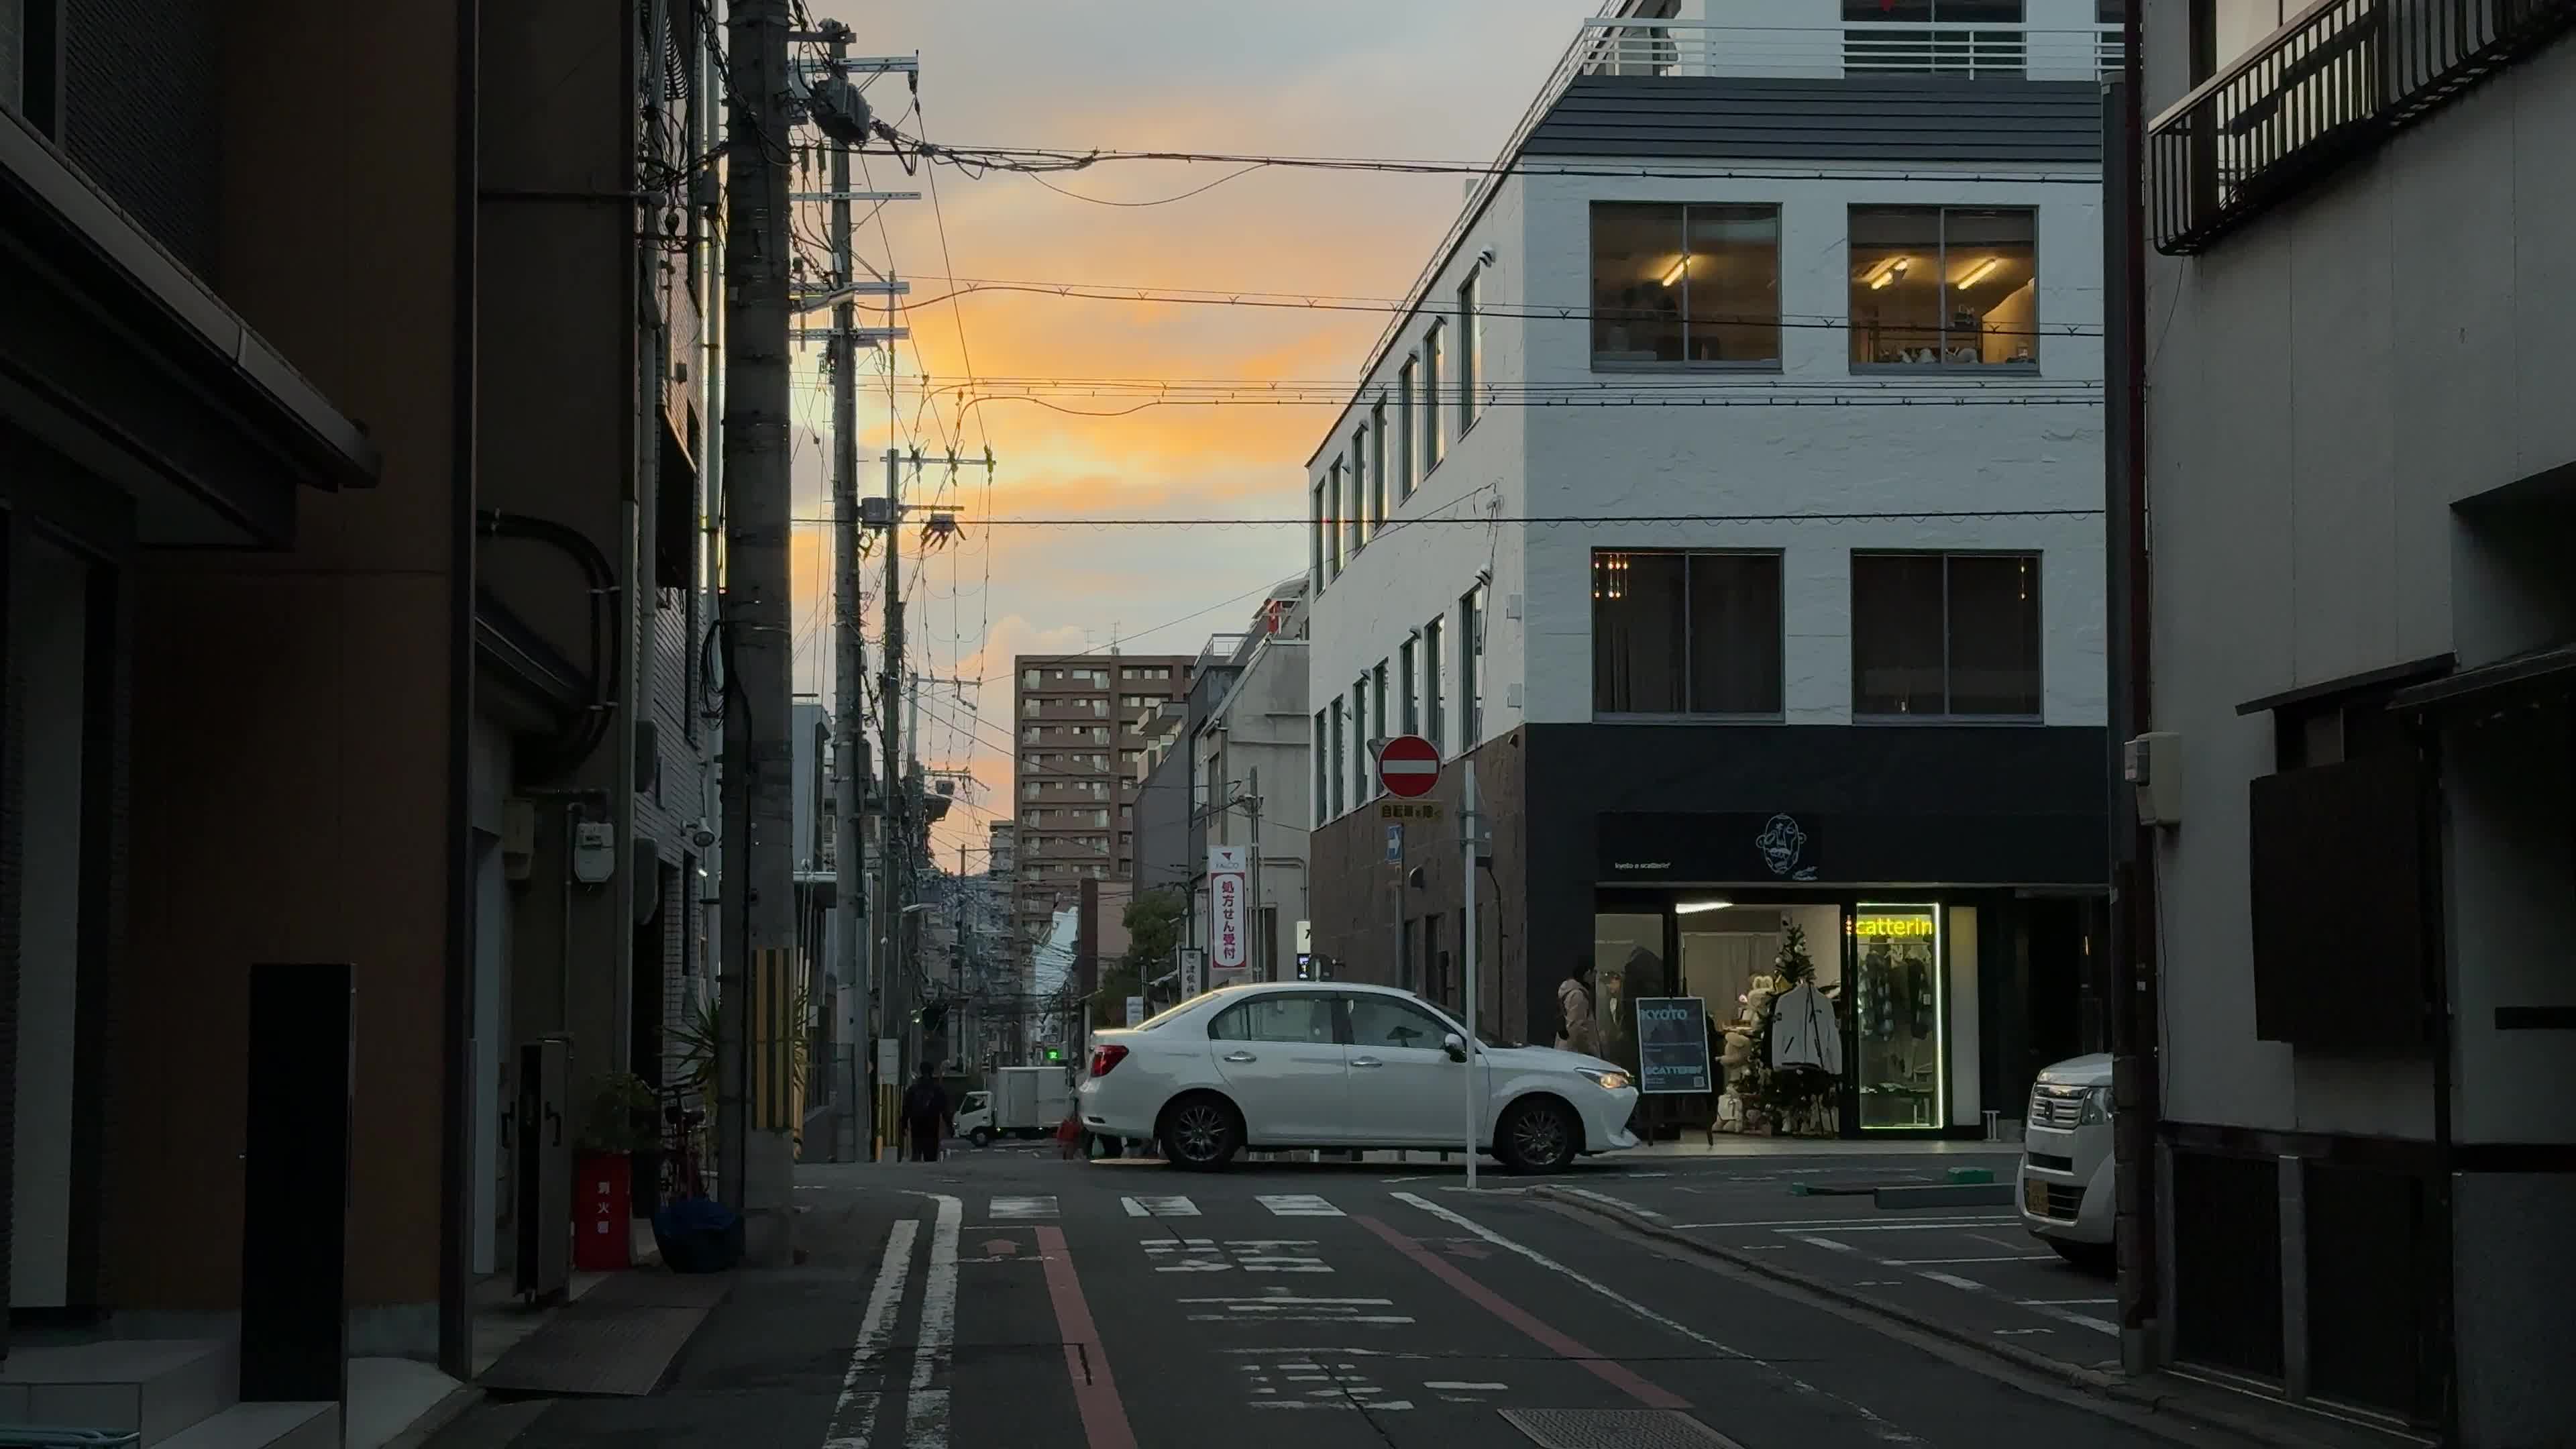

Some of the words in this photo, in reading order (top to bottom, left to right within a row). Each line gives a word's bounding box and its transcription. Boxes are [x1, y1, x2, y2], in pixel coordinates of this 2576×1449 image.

[1222, 881, 1236, 959] 処方せん受付
[1641, 1009, 1686, 1020] KYOTO
